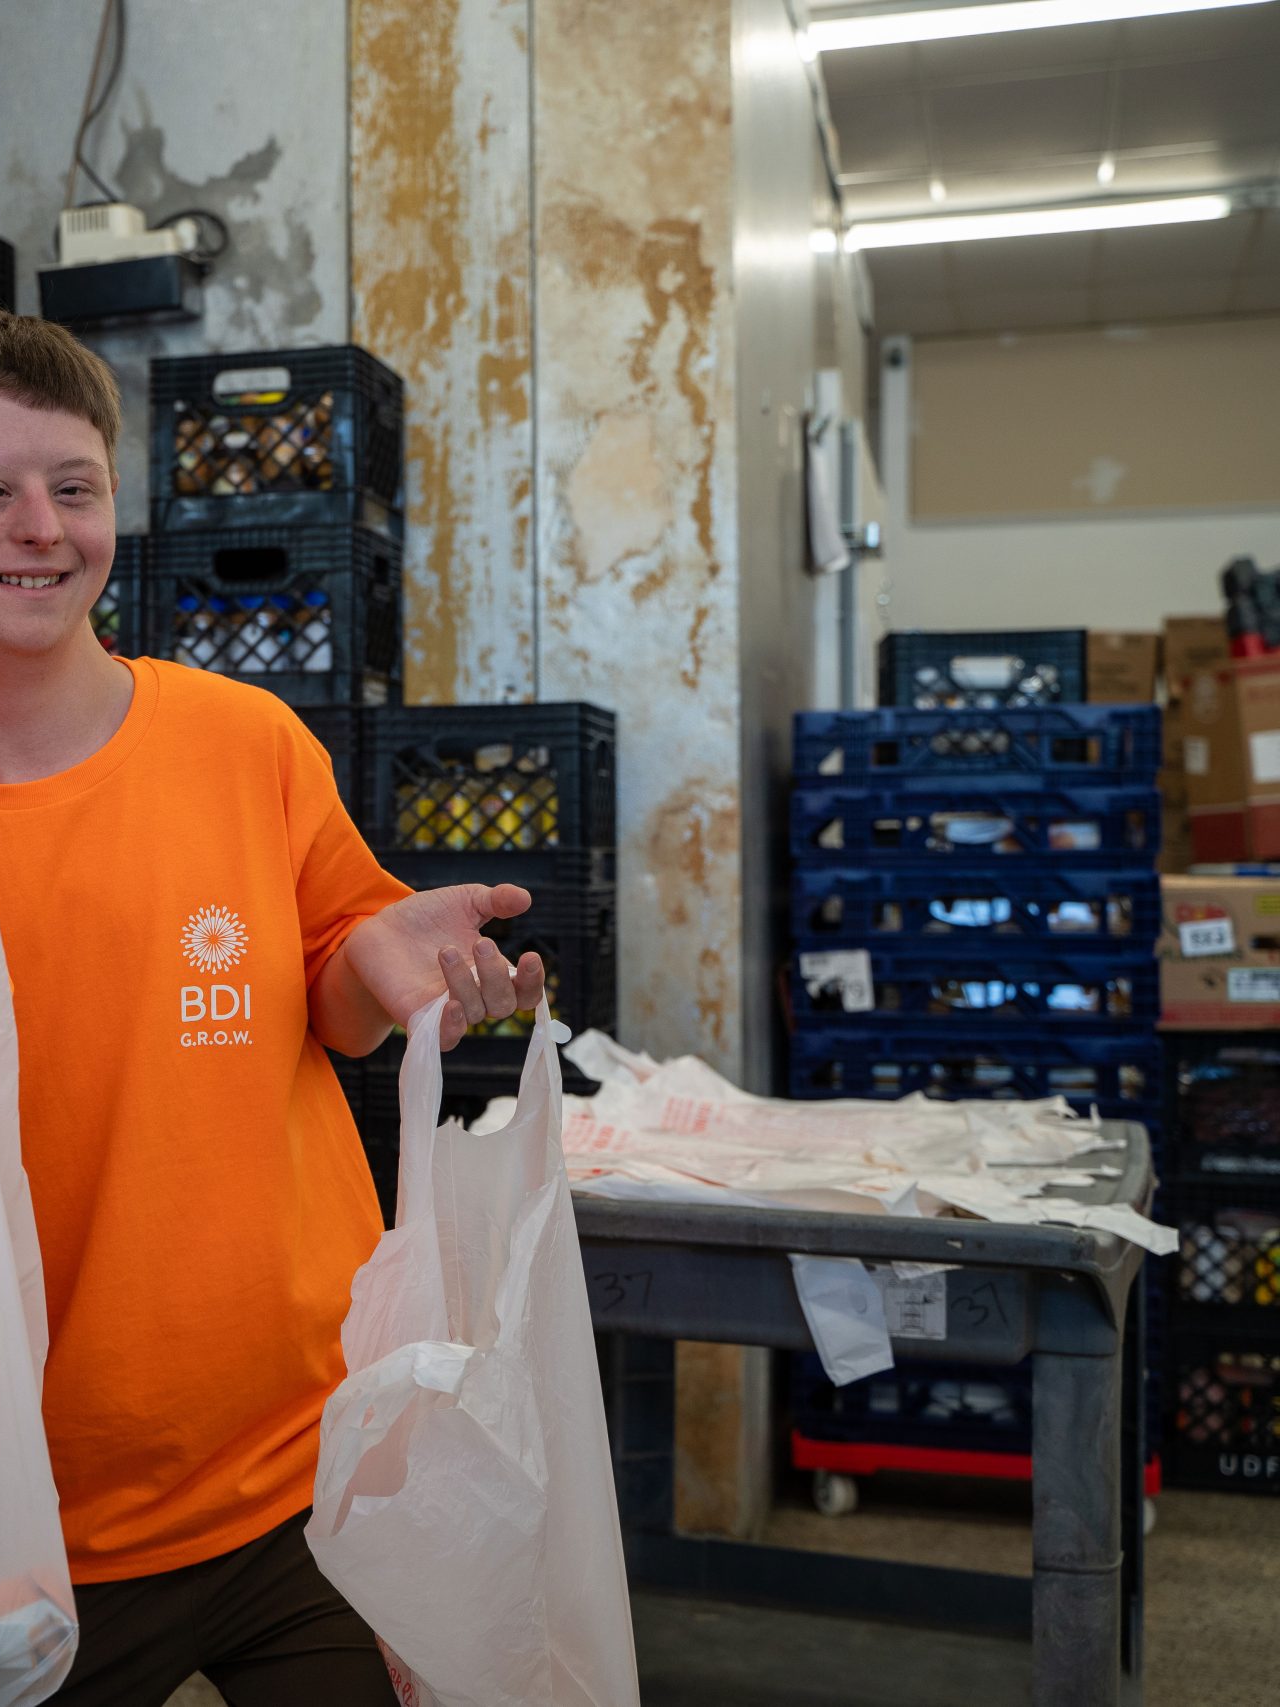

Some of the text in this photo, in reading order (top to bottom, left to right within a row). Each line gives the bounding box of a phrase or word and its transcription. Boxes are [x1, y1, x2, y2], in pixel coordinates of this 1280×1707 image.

[179, 983, 252, 1023] BDI
[180, 1030, 254, 1048] G.R.O.W.
[593, 1270, 654, 1314] 37
[950, 1281, 1009, 1327] 37
